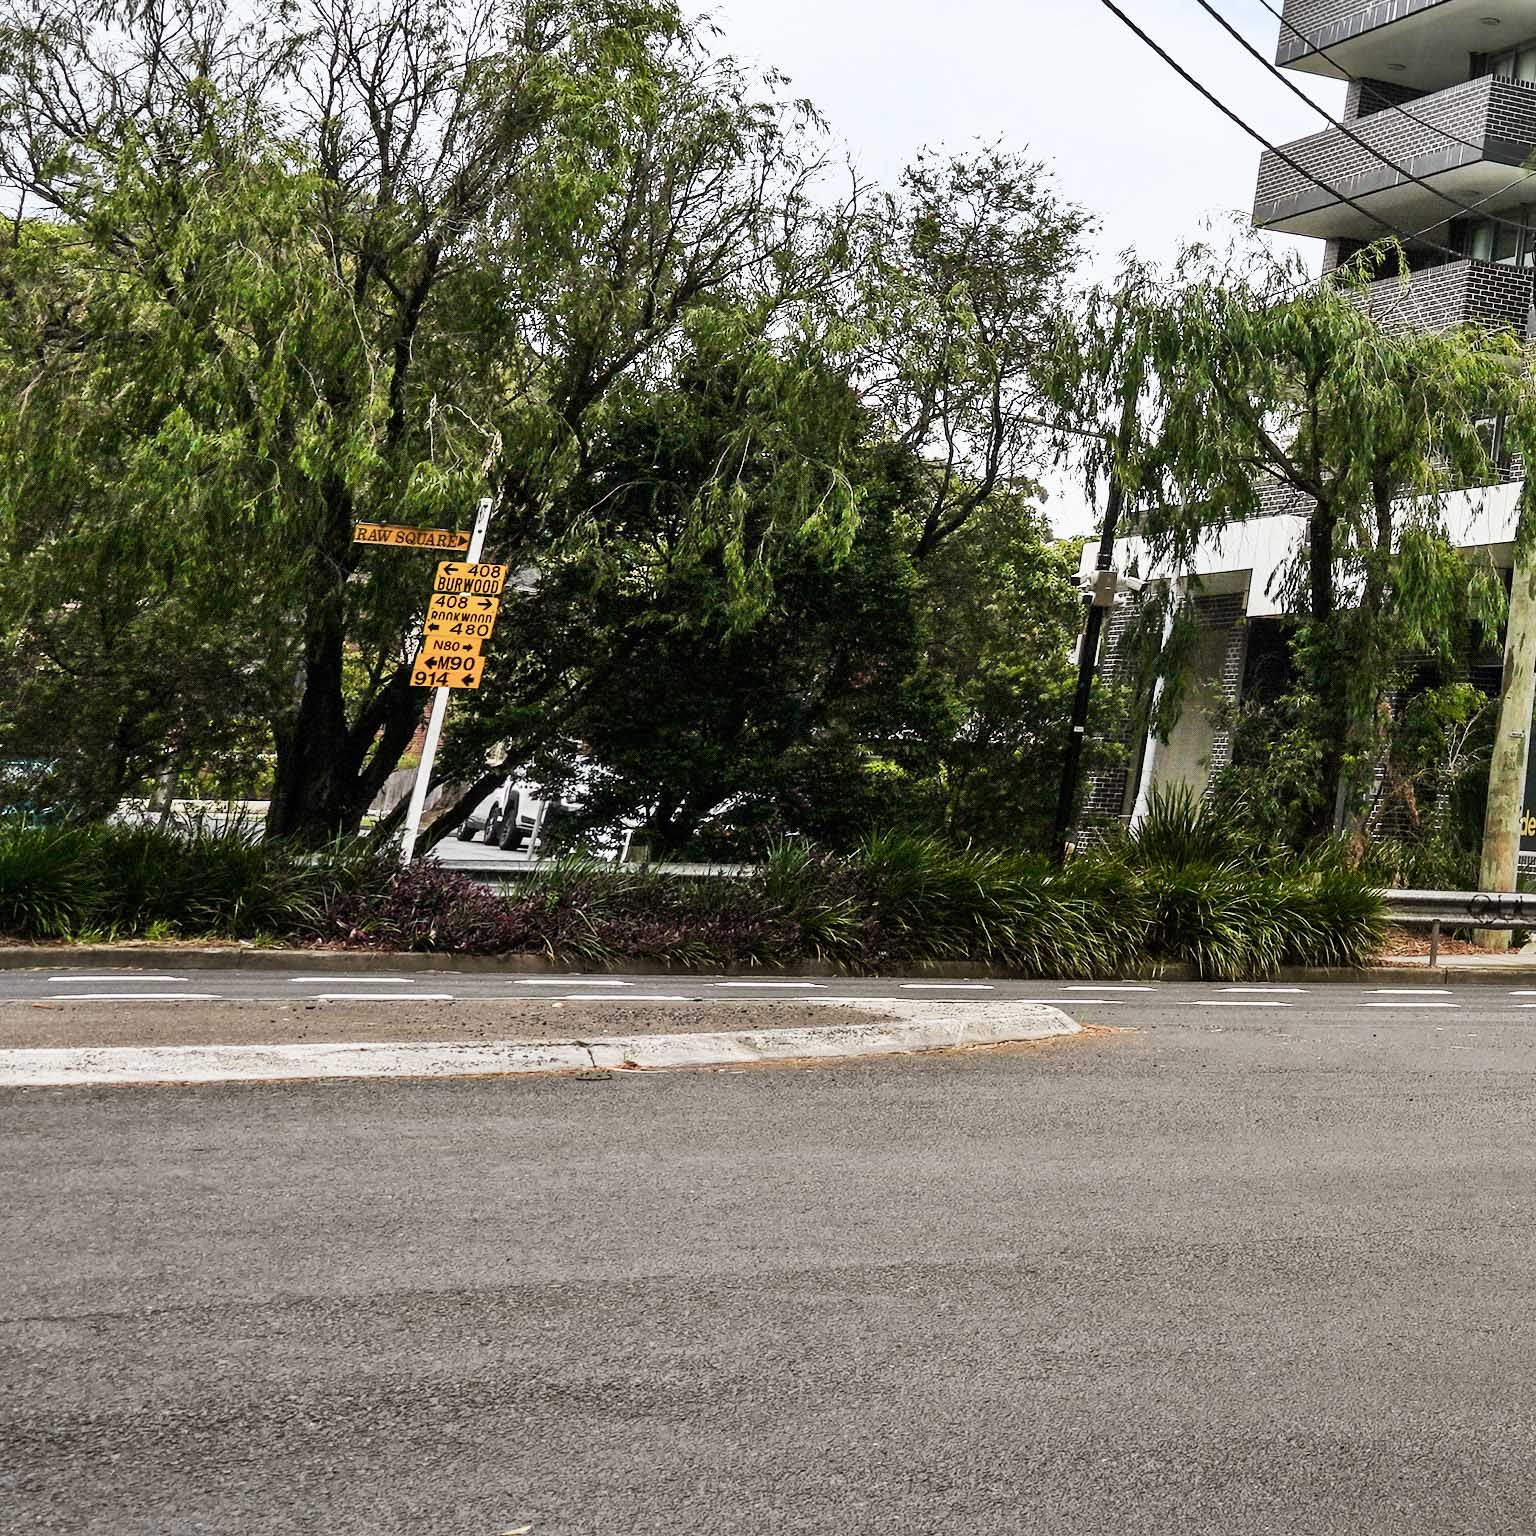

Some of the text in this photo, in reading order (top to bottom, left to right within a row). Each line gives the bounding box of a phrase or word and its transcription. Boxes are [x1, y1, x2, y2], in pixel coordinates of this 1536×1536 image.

[356, 528, 458, 548] RAW SQUARE
[468, 565, 500, 578] 408
[438, 577, 498, 593] BURWOOD
[435, 596, 468, 608] 408
[450, 623, 488, 636] 480
[433, 640, 460, 651] N80
[438, 656, 475, 670] M90
[415, 672, 448, 686] 914
